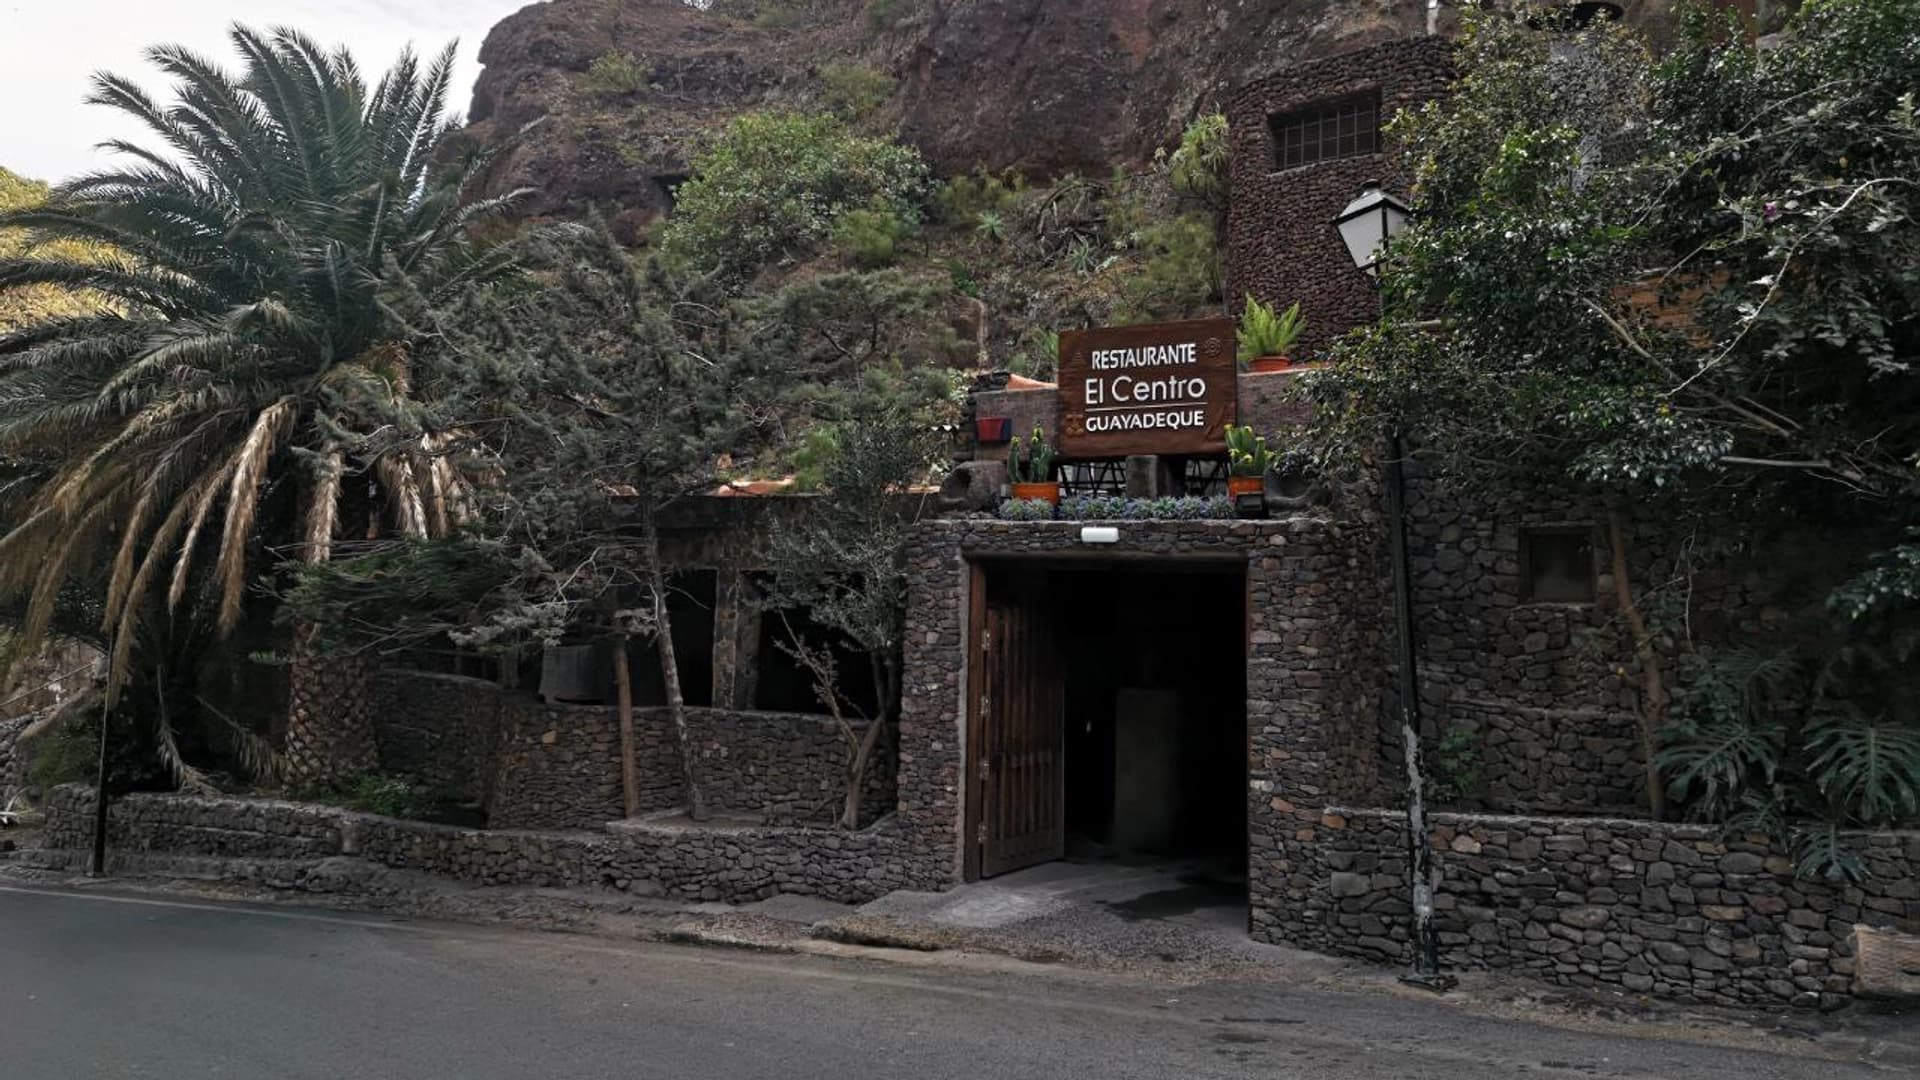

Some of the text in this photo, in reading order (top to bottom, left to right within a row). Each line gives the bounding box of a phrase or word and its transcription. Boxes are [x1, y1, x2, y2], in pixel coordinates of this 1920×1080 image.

[1091, 343, 1196, 370] RESTAURANTE
[1085, 375, 1206, 404] El Centro
[1086, 410, 1204, 432] GUAYADEQUE
